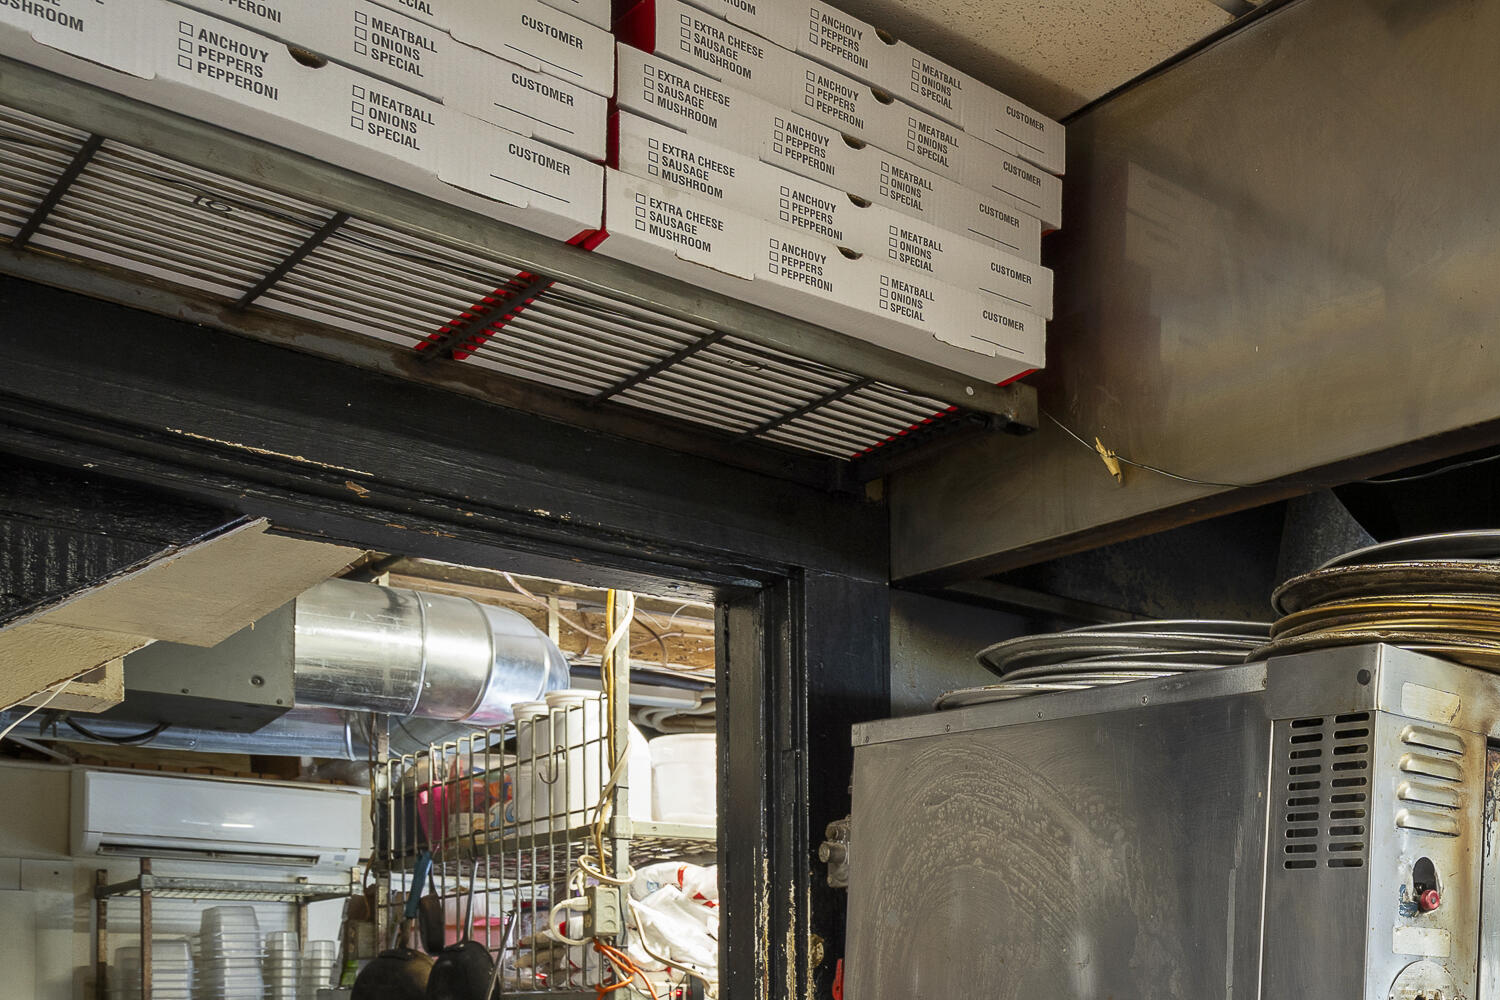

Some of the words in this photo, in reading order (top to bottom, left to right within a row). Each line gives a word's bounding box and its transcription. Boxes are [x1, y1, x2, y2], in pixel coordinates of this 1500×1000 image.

[372, 17, 438, 53] MEATBALL
[521, 14, 583, 49] CUSTOMER
[694, 20, 725, 42] EXTRA
[728, 35, 764, 59] CHEESE
[821, 14, 863, 40] ANCHOVY
[821, 26, 859, 52] PEPPERS
[198, 29, 269, 63] ANCHOVY
[371, 33, 420, 61] ONIONS
[693, 33, 738, 61] SAUSAGE
[820, 38, 868, 69] PEPPERONI
[198, 45, 263, 78] PEPPERS
[371, 48, 424, 77] SPECIAL
[693, 46, 752, 79] MUSHROOM
[197, 61, 278, 100] PEPPERONI
[511, 72, 574, 106] CUSTOMER
[658, 70, 690, 91] EXTRA
[693, 84, 730, 107] CHEESE
[817, 76, 859, 101] ANCHOVY
[921, 75, 951, 96] ONIONS
[922, 63, 962, 90] MEATBALL
[369, 91, 435, 125] MEATBALL
[657, 82, 704, 110] SAUSAGE
[817, 88, 855, 113] PEPPERS
[920, 86, 952, 110] SPECIAL
[368, 107, 417, 134] ONIONS
[657, 96, 718, 129] MUSHROOM
[816, 100, 864, 129] PEPPERONI
[1006, 105, 1044, 132] CUSTOMER
[368, 122, 420, 150] SPECIAL
[785, 135, 826, 159] PEPPERS
[786, 122, 830, 147] ANCHOVY
[917, 134, 948, 154] ONIONS
[918, 122, 959, 148] MEATBALL
[508, 143, 571, 176] CUSTOMER
[662, 142, 695, 163] EXTRA
[697, 155, 735, 178] CHEESE
[662, 156, 709, 181] SAUSAGE
[785, 147, 835, 176] PEPPERONI
[916, 145, 949, 168] SPECIAL
[661, 169, 723, 199] MUSHROOM
[891, 166, 933, 191] MEATBALL
[1003, 161, 1041, 187] CUSTOMER
[890, 189, 923, 211] SPECIAL
[891, 178, 922, 198] ONIONS
[649, 197, 683, 218] EXTRA
[686, 210, 724, 231] CHEESE
[792, 190, 836, 213] ANCHOVY
[792, 203, 833, 225] PEPPERS
[649, 211, 697, 235] SAUSAGE
[791, 214, 843, 241] PEPPERONI
[979, 203, 1020, 228] CUSTOMER
[649, 224, 711, 253] MUSHROOM
[899, 241, 932, 260] ONIONS
[900, 229, 943, 252] MEATBALL
[781, 242, 827, 265] ANCHOVY
[781, 255, 823, 276] PEPPERS
[899, 253, 934, 272] SPECIAL
[781, 267, 833, 292] PEPPERONI
[990, 262, 1032, 285] CUSTOMER
[890, 291, 923, 309] ONIONS
[891, 279, 935, 302] MEATBALL
[890, 303, 925, 322] SPECIAL
[982, 310, 1025, 332] CUSTOMER
